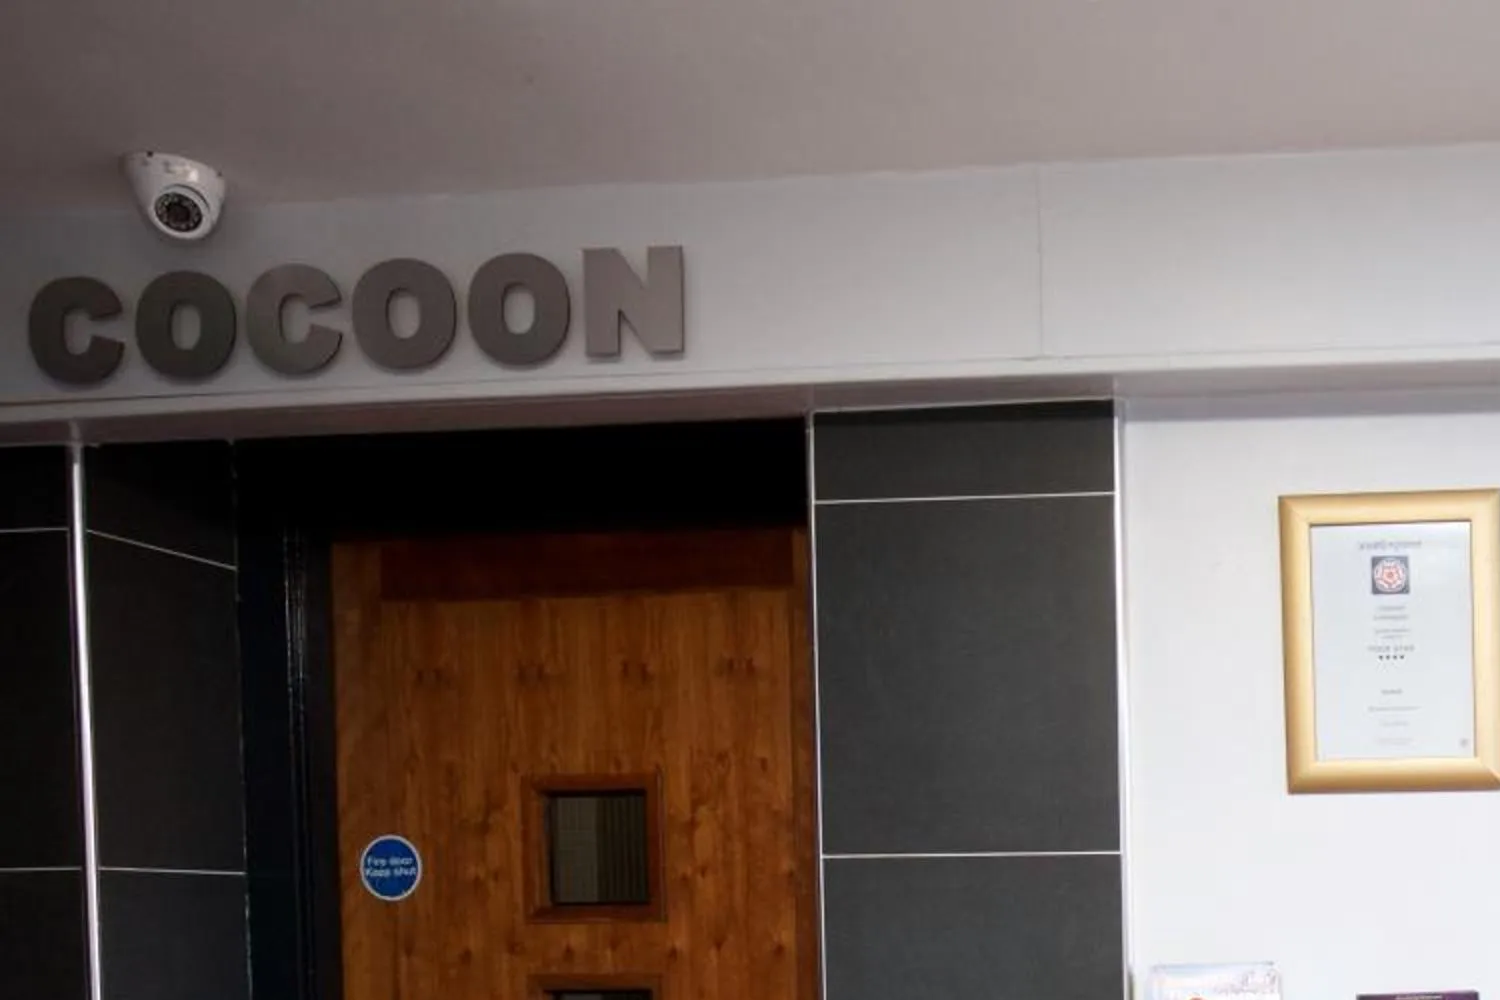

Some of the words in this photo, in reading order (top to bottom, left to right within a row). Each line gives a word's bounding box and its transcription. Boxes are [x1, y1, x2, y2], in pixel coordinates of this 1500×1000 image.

[27, 245, 686, 386] COCOON
[367, 856, 387, 867] Fire
[394, 867, 416, 876] shut
